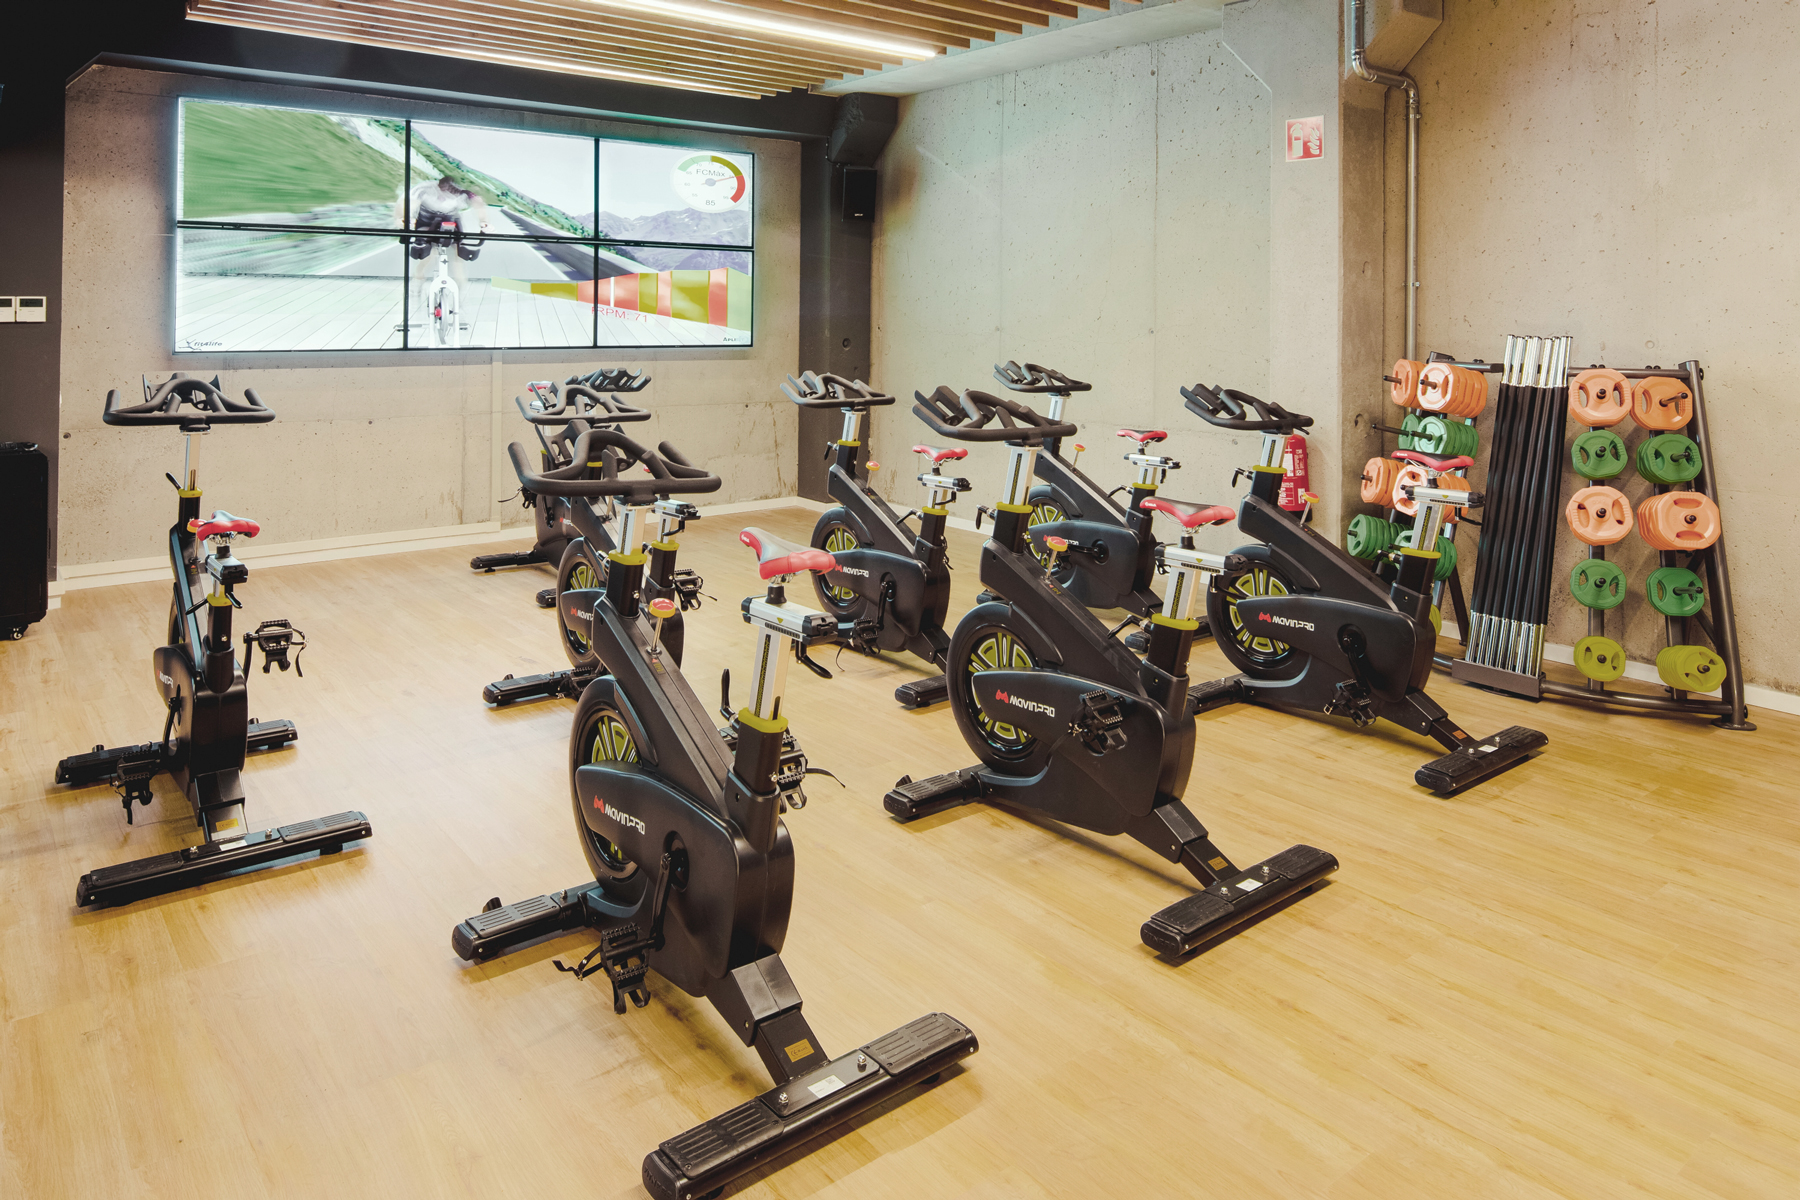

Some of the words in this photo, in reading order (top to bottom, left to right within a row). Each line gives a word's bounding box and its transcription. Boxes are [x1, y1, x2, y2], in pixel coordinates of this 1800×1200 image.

[634, 312, 647, 322] 71
[1272, 615, 1315, 631] MOVINPRO
[1009, 694, 1055, 717] MOVINPRO
[604, 803, 645, 835] MOVINPRO
